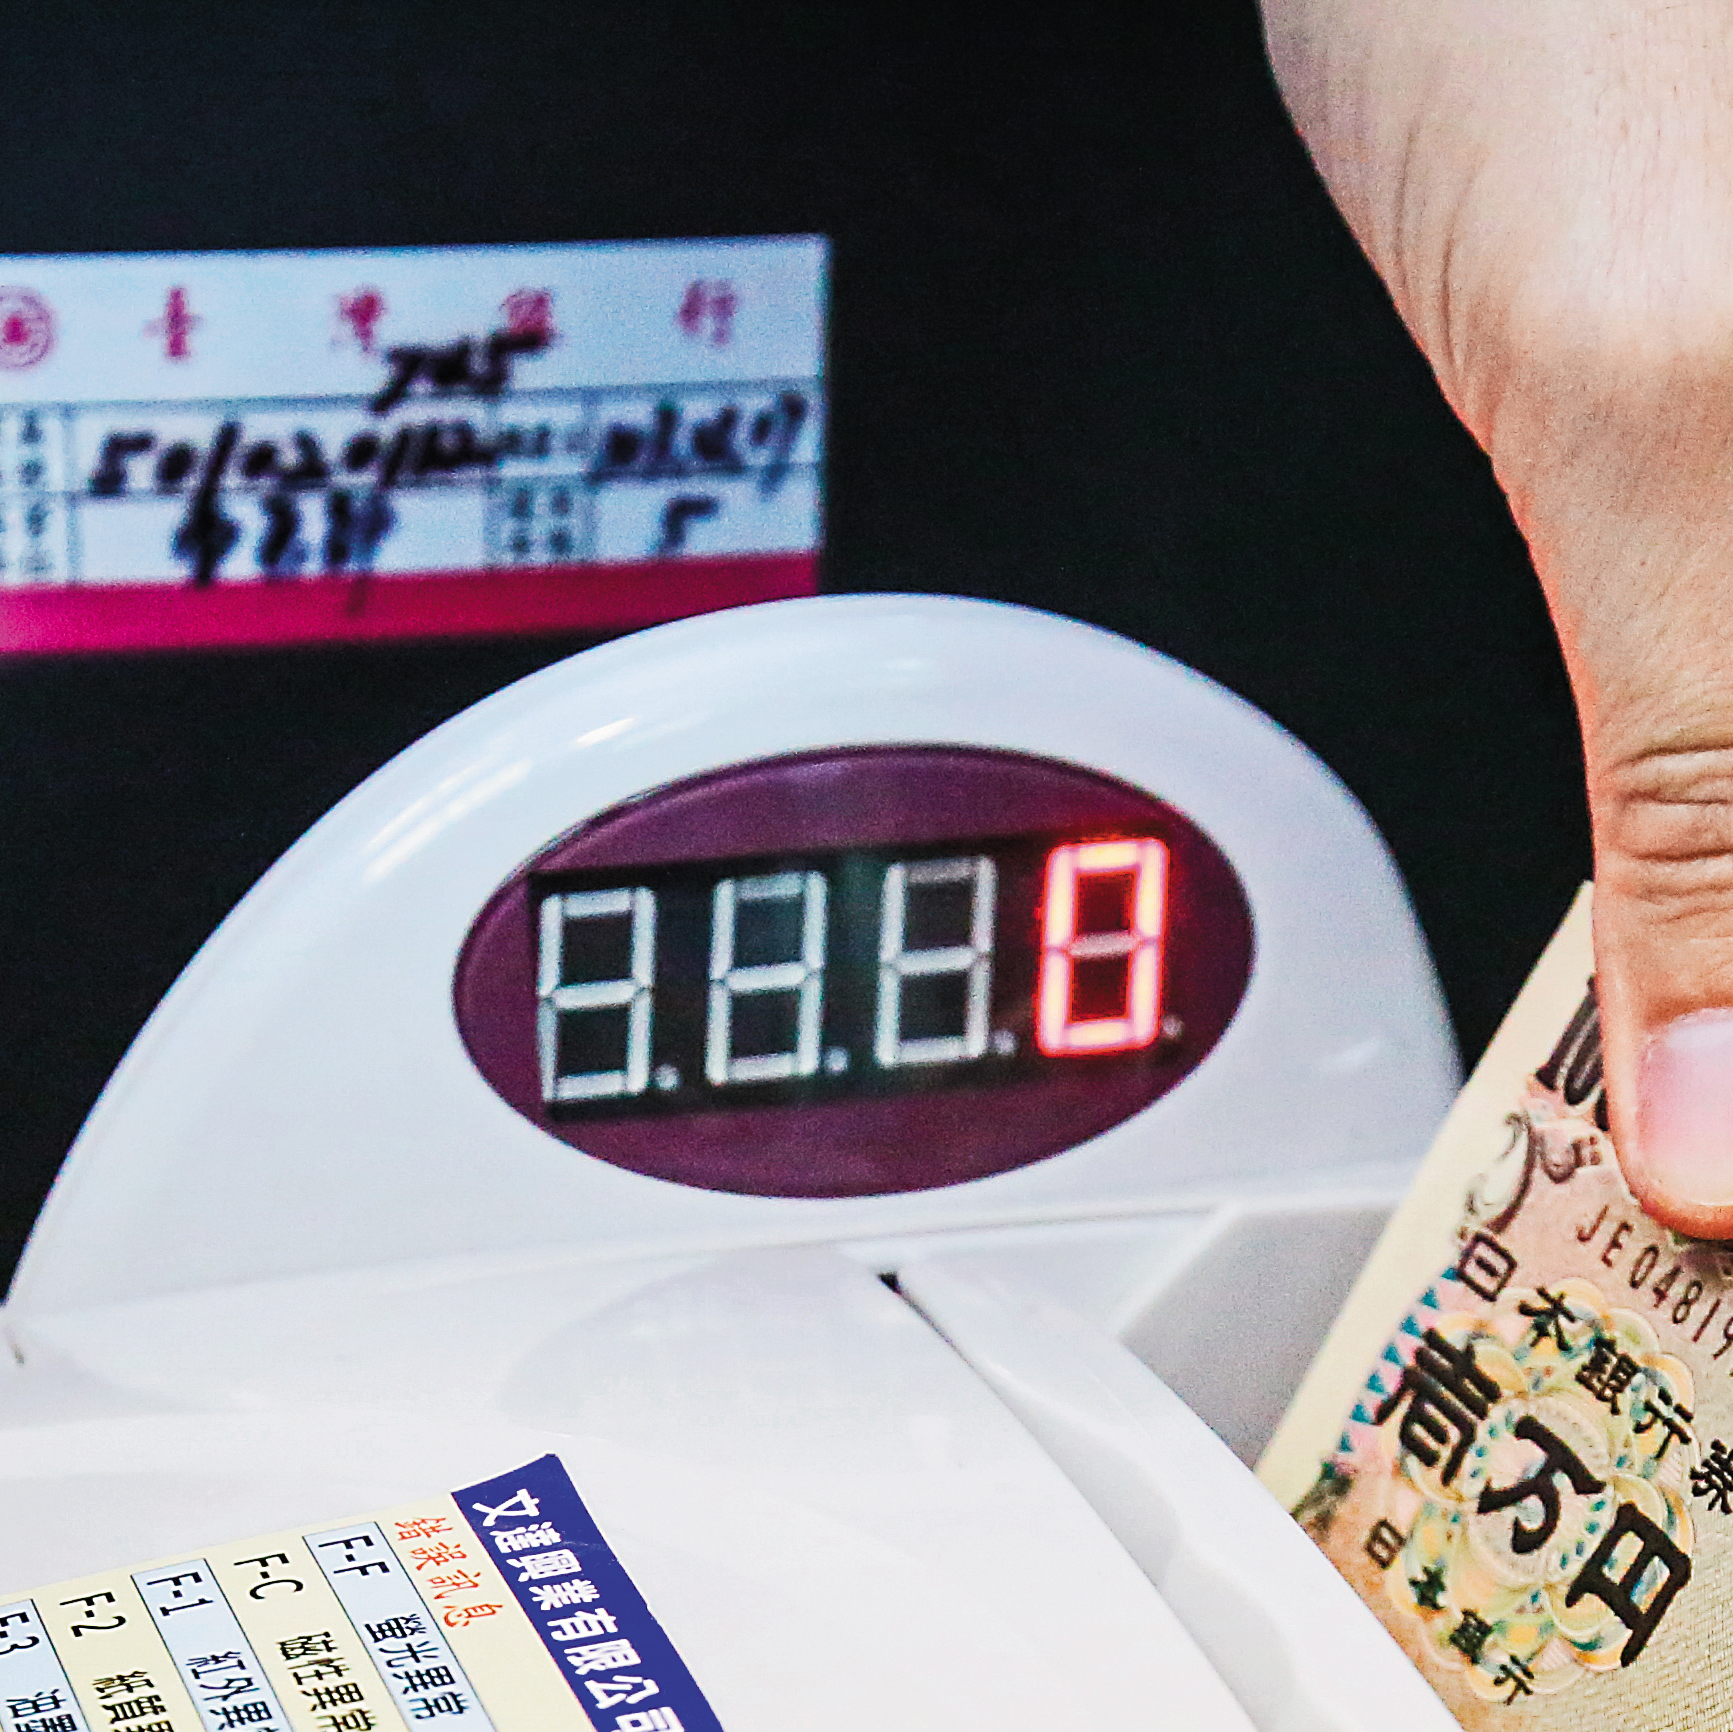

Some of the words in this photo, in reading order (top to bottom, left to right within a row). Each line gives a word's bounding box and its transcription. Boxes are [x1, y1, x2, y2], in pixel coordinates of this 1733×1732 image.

[147, 1572, 213, 1617] F-1
[234, 1553, 304, 1600] F-C
[395, 1517, 502, 1627] 錯誤訊息
[60, 1591, 126, 1637] F-2
[319, 1535, 390, 1576] F-F
[365, 1614, 466, 1720] 螢光異常
[1365, 1518, 1534, 1706] 日本銀行
